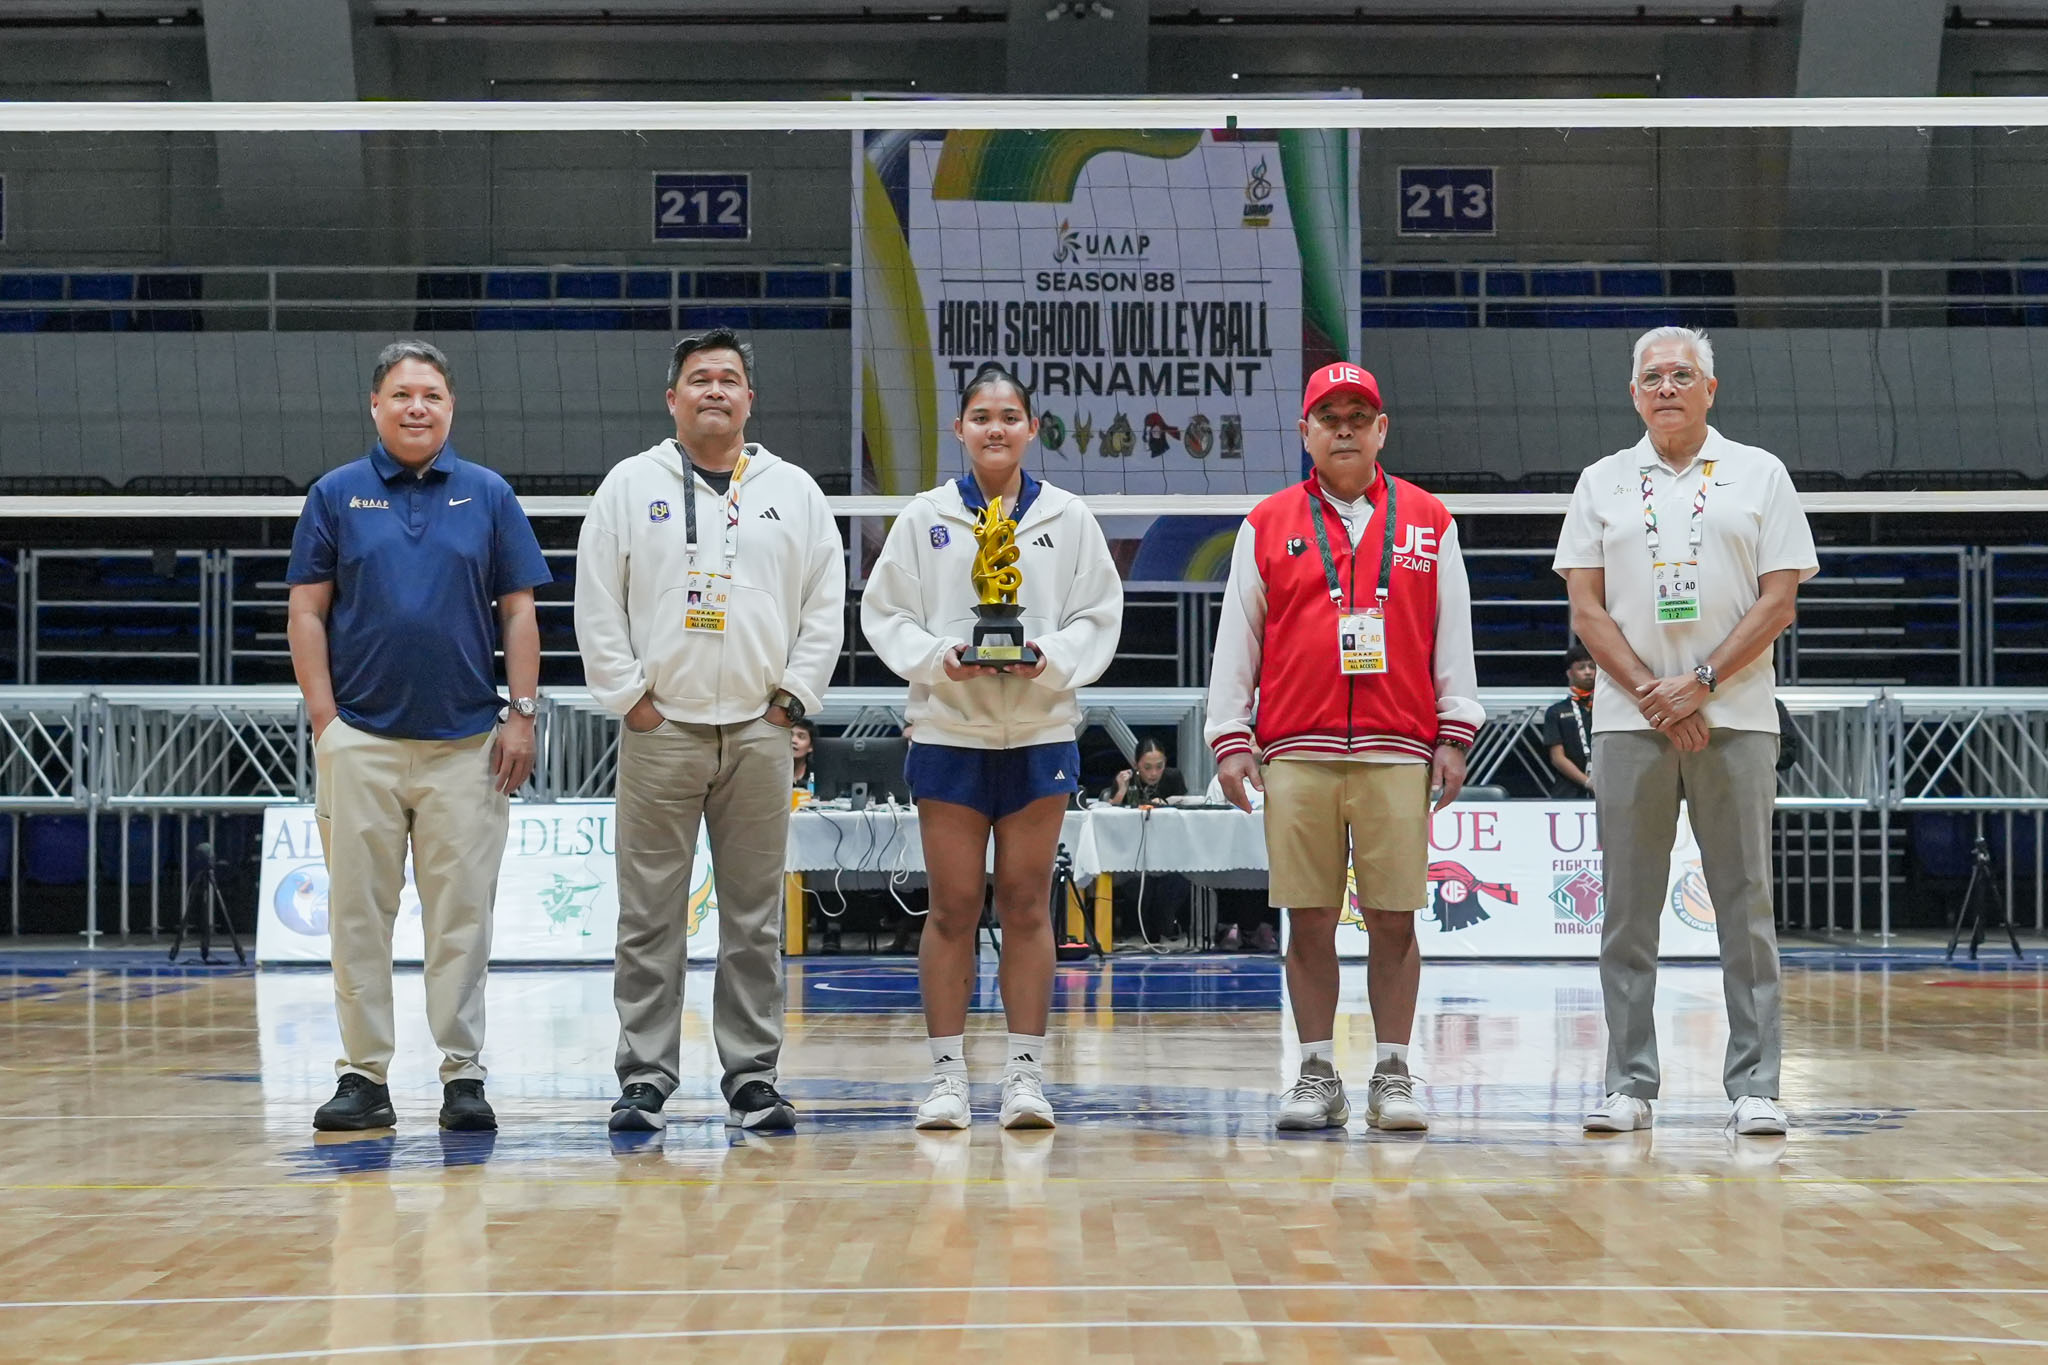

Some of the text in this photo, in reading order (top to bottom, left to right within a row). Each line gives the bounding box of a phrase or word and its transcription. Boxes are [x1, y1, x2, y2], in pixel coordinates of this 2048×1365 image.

[661, 190, 741, 224] 212
[1406, 184, 1488, 218] 213
[1086, 234, 1150, 255] UAAP
[1036, 271, 1175, 292] SEASON 88
[938, 300, 1272, 357] HIGH SCHOOL VOLLEYBALL
[1328, 366, 1361, 385] UE
[1393, 555, 1431, 573] PZMB
[1674, 581, 1696, 591] C AD
[1428, 811, 1501, 851] UE
